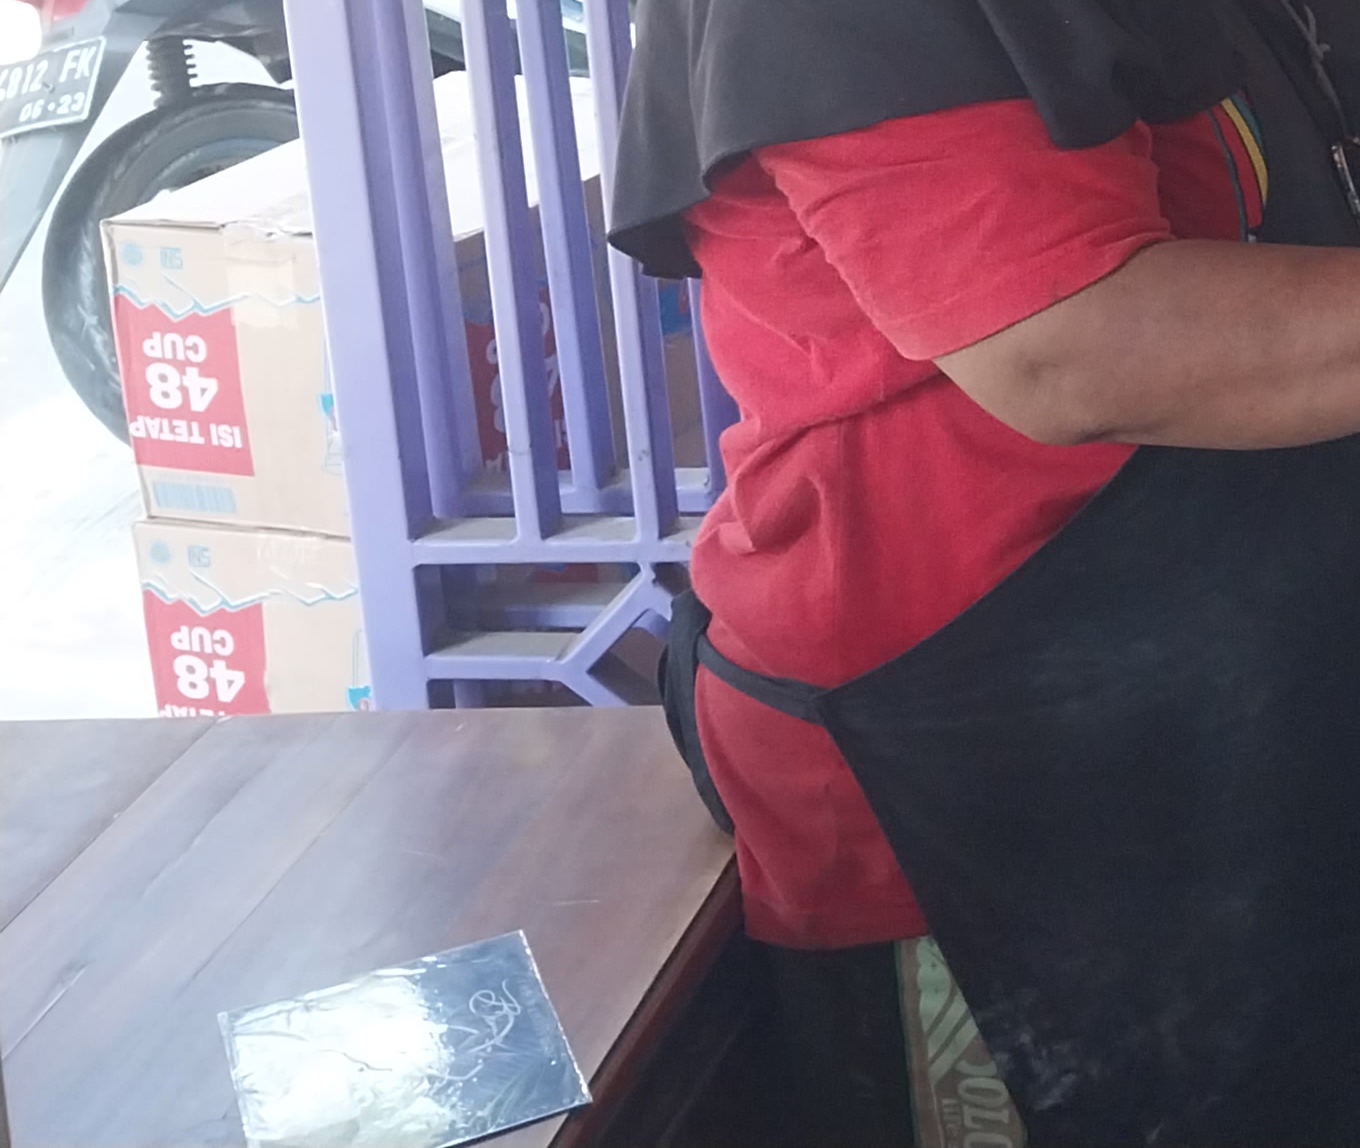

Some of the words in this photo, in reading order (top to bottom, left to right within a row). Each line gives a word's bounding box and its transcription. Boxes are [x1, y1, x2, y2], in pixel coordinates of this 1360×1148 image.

[58, 45, 97, 83] FK
[142, 330, 207, 362] CUP
[145, 362, 219, 411] 48
[130, 413, 205, 444] TETAP
[211, 422, 242, 449] ISI
[170, 625, 235, 655] CUP
[172, 654, 245, 703] 48
